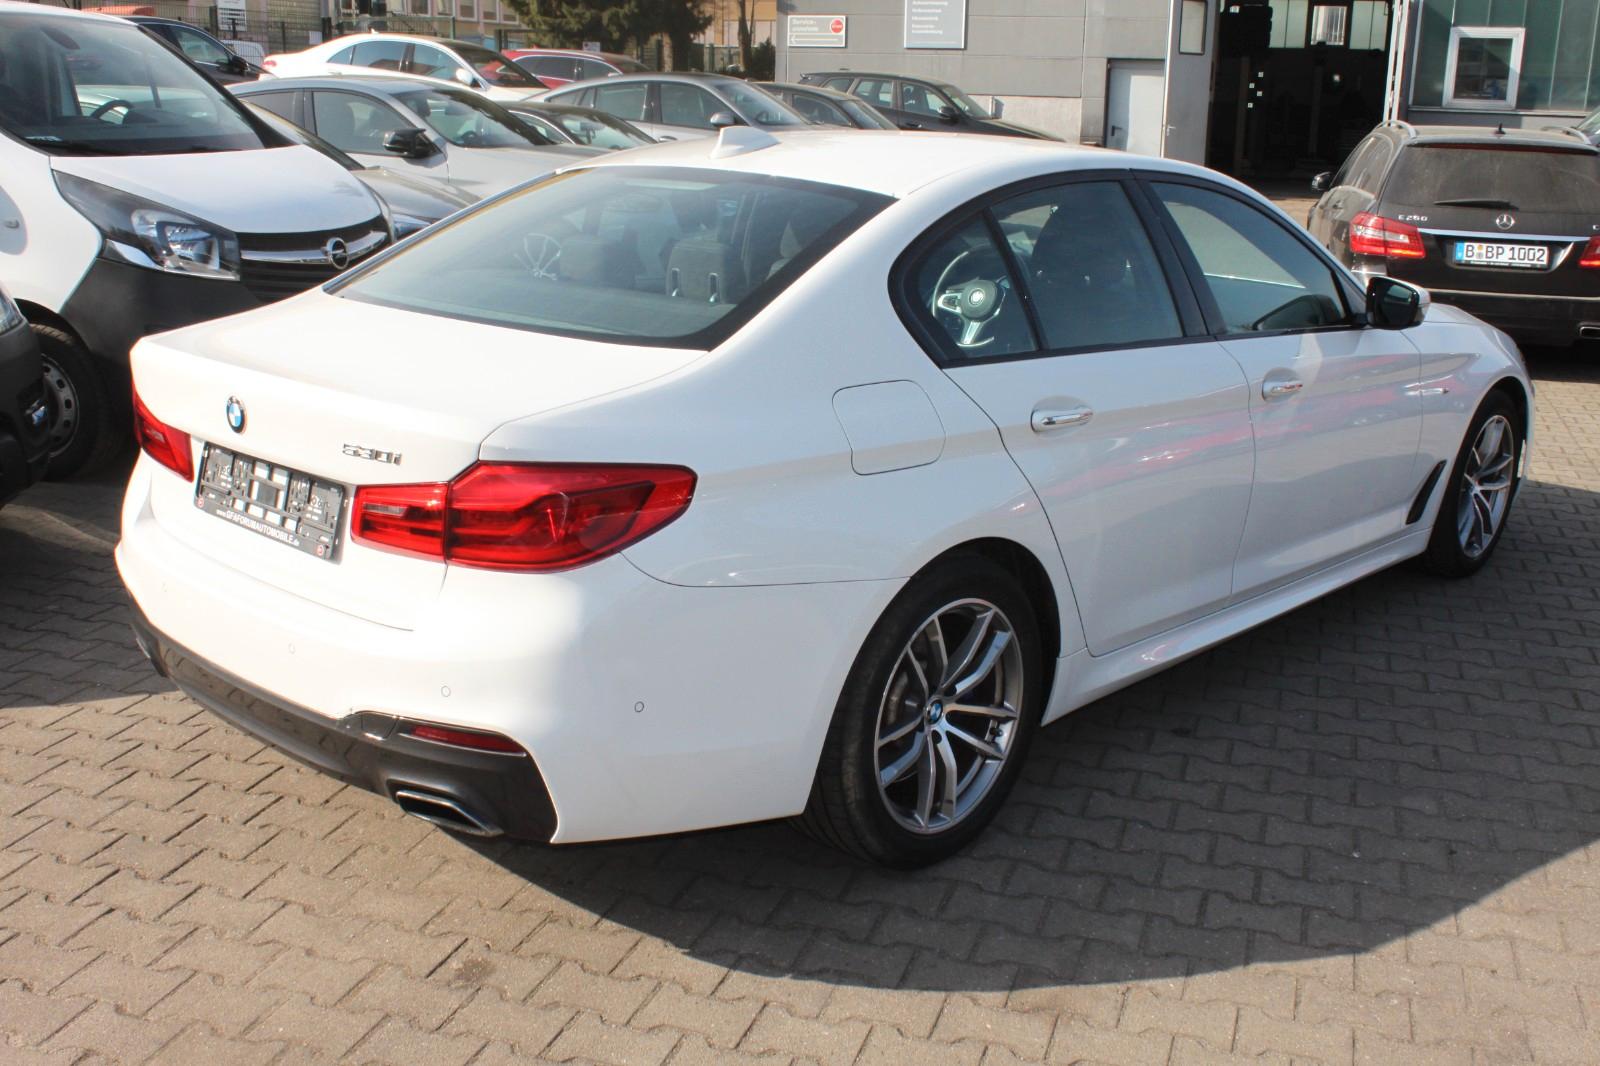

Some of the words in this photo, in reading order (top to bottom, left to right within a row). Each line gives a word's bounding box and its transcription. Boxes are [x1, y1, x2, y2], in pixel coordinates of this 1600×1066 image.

[1465, 244, 1475, 258] B
[1485, 245, 1505, 260] BP
[1508, 246, 1546, 262] 1002
